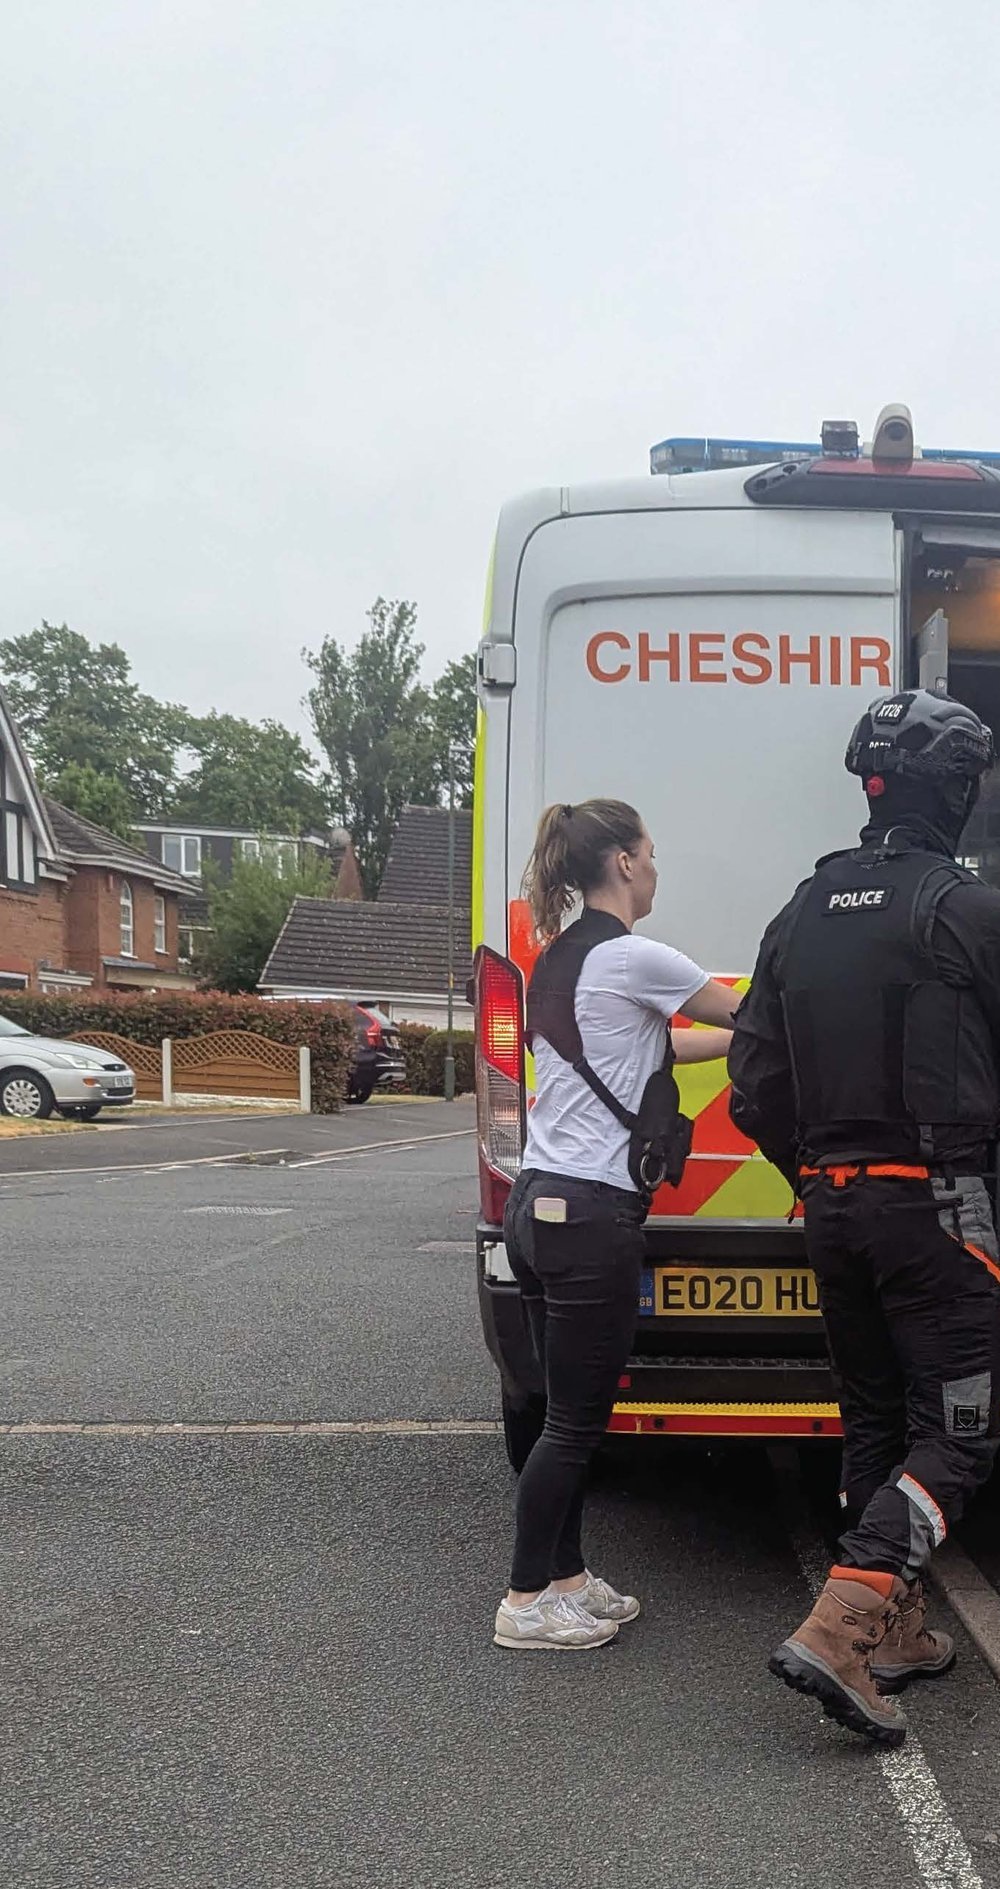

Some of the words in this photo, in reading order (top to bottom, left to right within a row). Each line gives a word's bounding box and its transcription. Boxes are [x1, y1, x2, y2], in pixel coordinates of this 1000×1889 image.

[586, 631, 891, 687] CHESHIR
[828, 890, 885, 909] POLICE
[639, 1297, 652, 1307] GB
